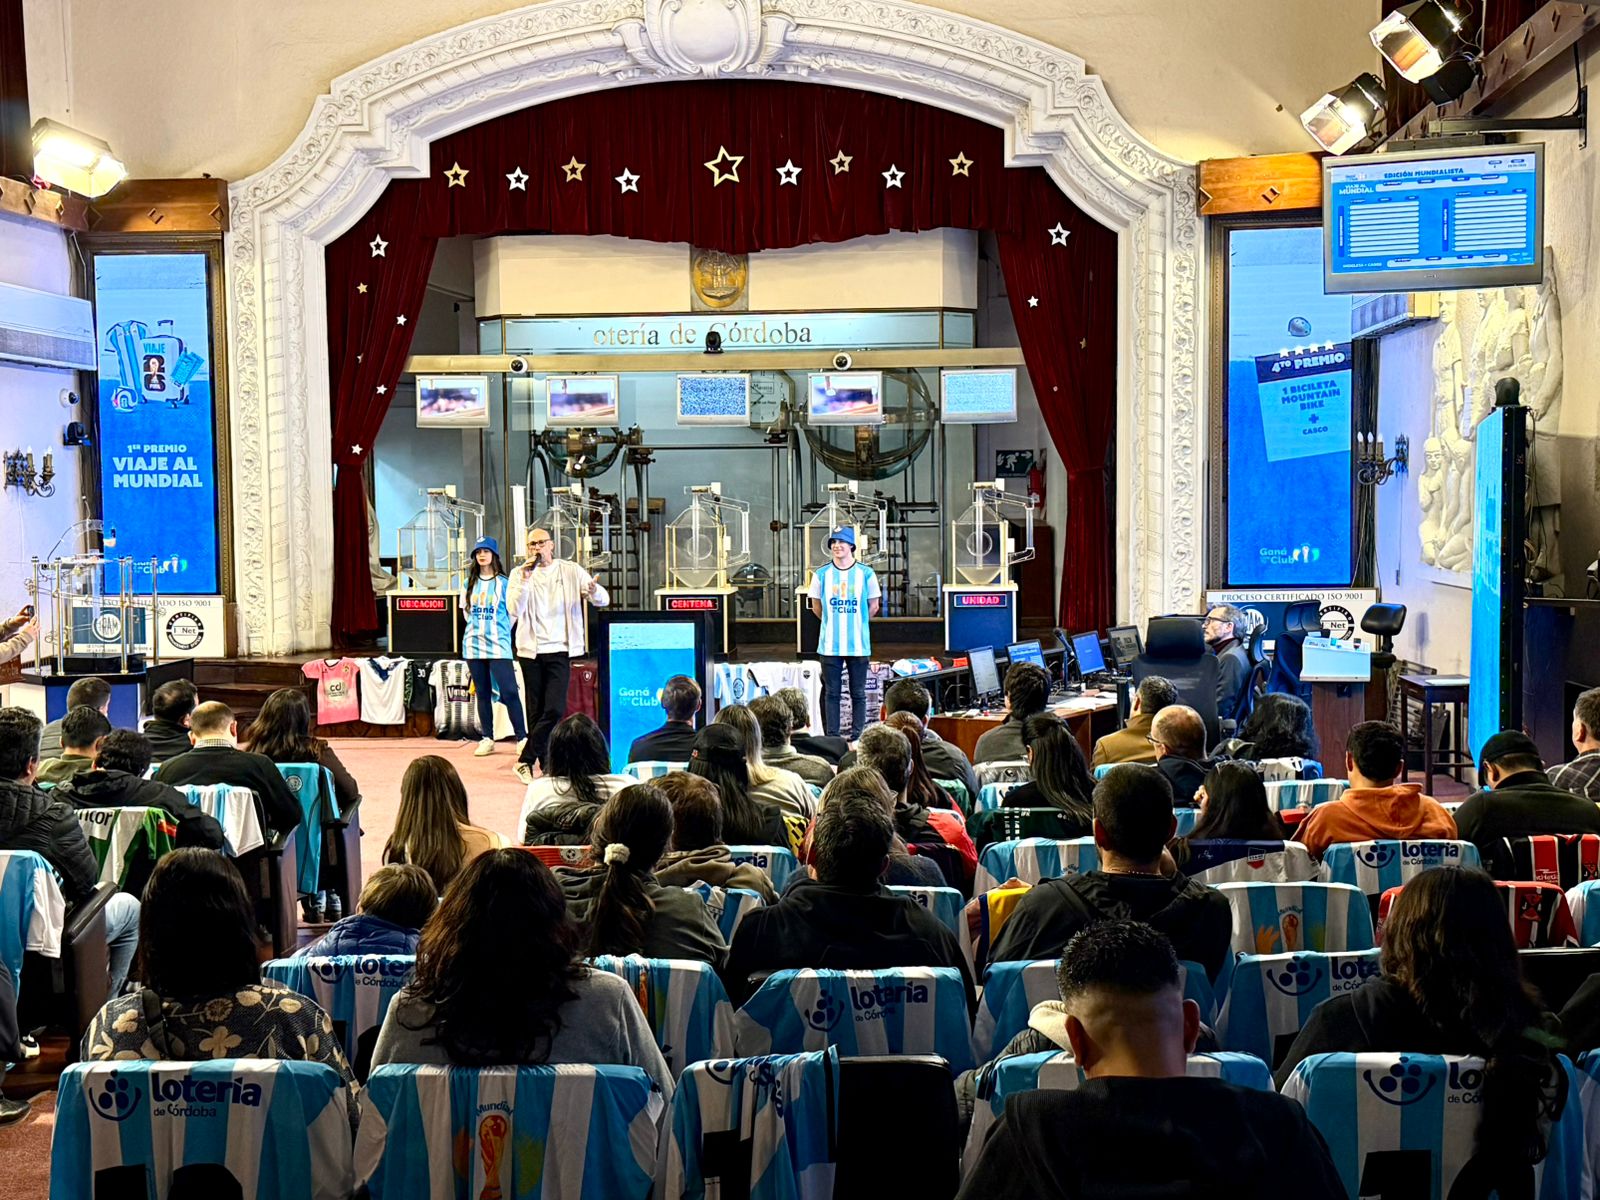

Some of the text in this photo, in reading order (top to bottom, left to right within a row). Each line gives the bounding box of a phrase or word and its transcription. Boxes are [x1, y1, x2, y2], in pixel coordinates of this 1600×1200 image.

[1414, 168, 1464, 176] MUNDIALISTA
[1339, 187, 1374, 195] MUNDIAL
[594, 320, 812, 346] otería de Córdoba
[144, 343, 166, 354] VIAJE
[1294, 352, 1346, 370] PREMIO
[1290, 380, 1338, 393] BICILETA
[1282, 388, 1340, 405] MOUNTAIN
[1300, 400, 1324, 411] BIKE
[1302, 426, 1328, 435] CASCO
[144, 444, 187, 453] PREMIO
[112, 456, 198, 471] VIAJE AL
[113, 474, 204, 488] MUNDIAL
[1260, 547, 1288, 556] Ganá
[1270, 556, 1295, 564] Club
[671, 600, 713, 608] CENTENA
[830, 597, 858, 606] Ganá
[962, 596, 1000, 605] UNIDAD
[330, 682, 342, 692] cd
[619, 687, 649, 696] Ganá
[631, 697, 658, 706] Club
[1402, 842, 1459, 858] lotería
[1331, 956, 1381, 980] lote
[850, 981, 928, 1011] lotería
[152, 1072, 262, 1107] lotería
[1448, 1095, 1460, 1104] de
[154, 1104, 216, 1118] de Córdoba
